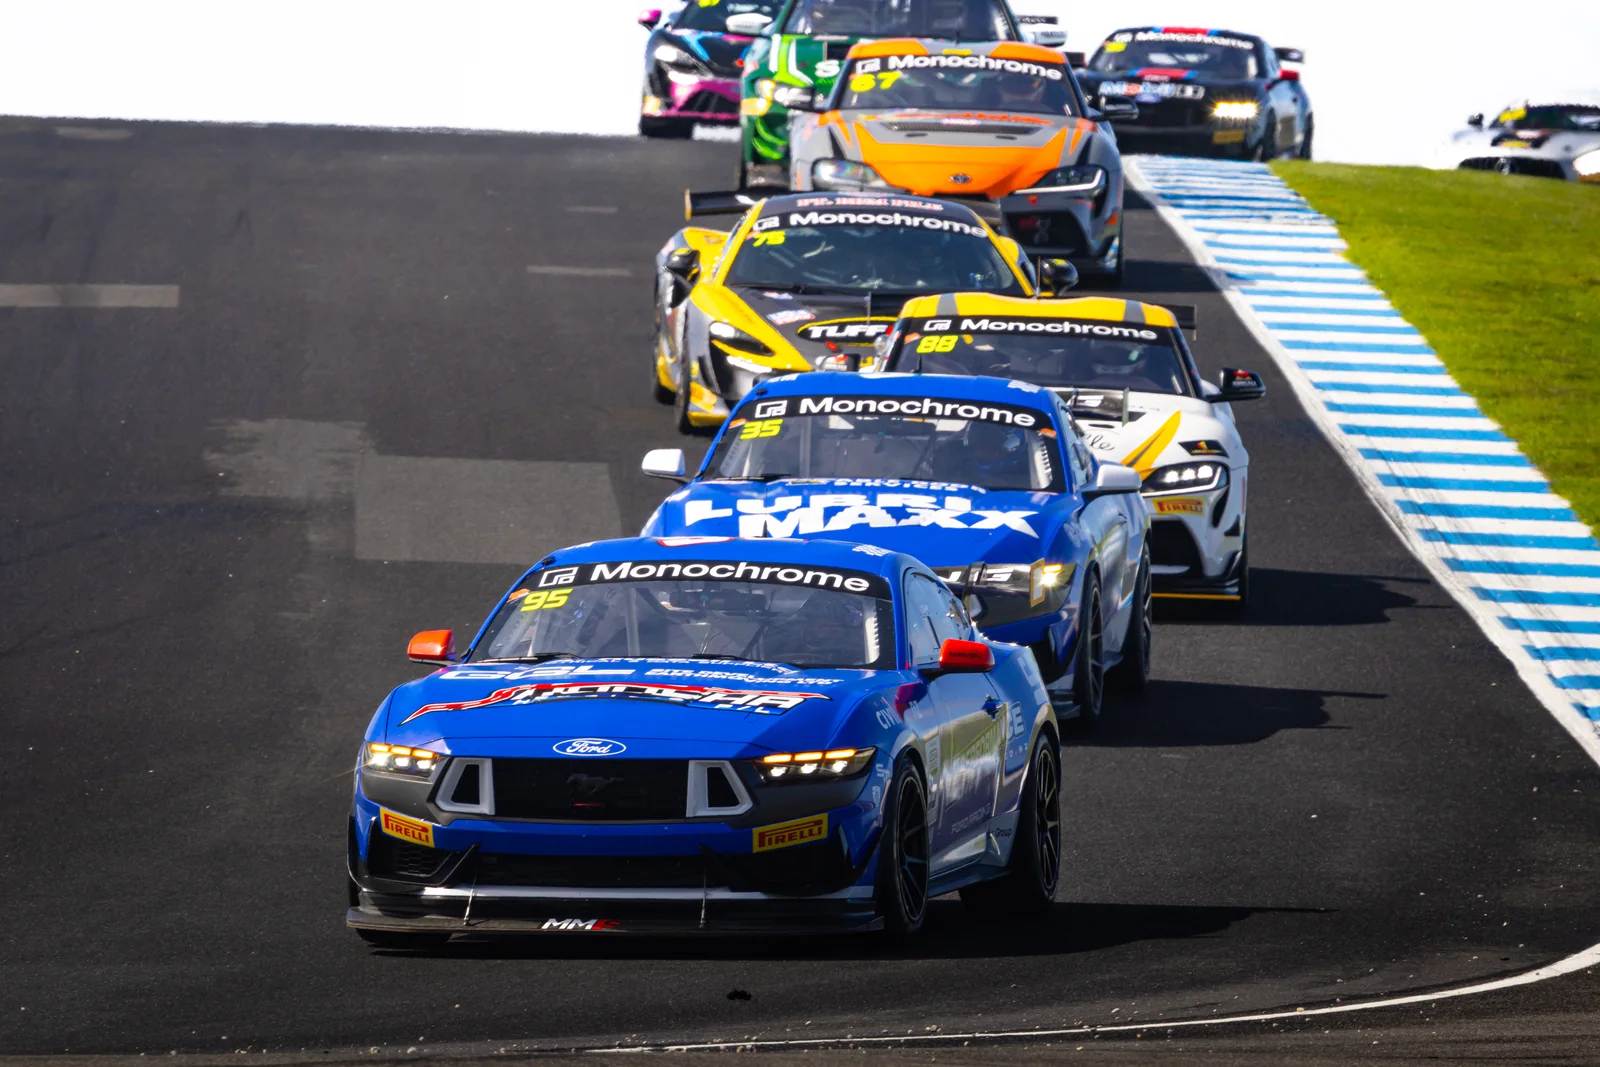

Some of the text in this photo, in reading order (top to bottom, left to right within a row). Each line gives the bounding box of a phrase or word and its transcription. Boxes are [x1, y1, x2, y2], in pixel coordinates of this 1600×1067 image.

[889, 54, 1063, 81] Monochrome
[849, 71, 901, 92] 67
[789, 211, 989, 237] Monochrome
[753, 230, 785, 247] 75
[959, 318, 1158, 340] Monochrome
[916, 335, 958, 353] 88
[798, 397, 1036, 427] Monochrome
[739, 419, 783, 440] 35
[685, 493, 972, 526] LUBRI
[590, 562, 870, 592] Monochrome
[520, 588, 573, 613] 95
[566, 740, 612, 753] Ford
[384, 813, 430, 843] PIRELLI
[757, 818, 823, 848] PIRELLI
[994, 827, 1012, 838] Group
